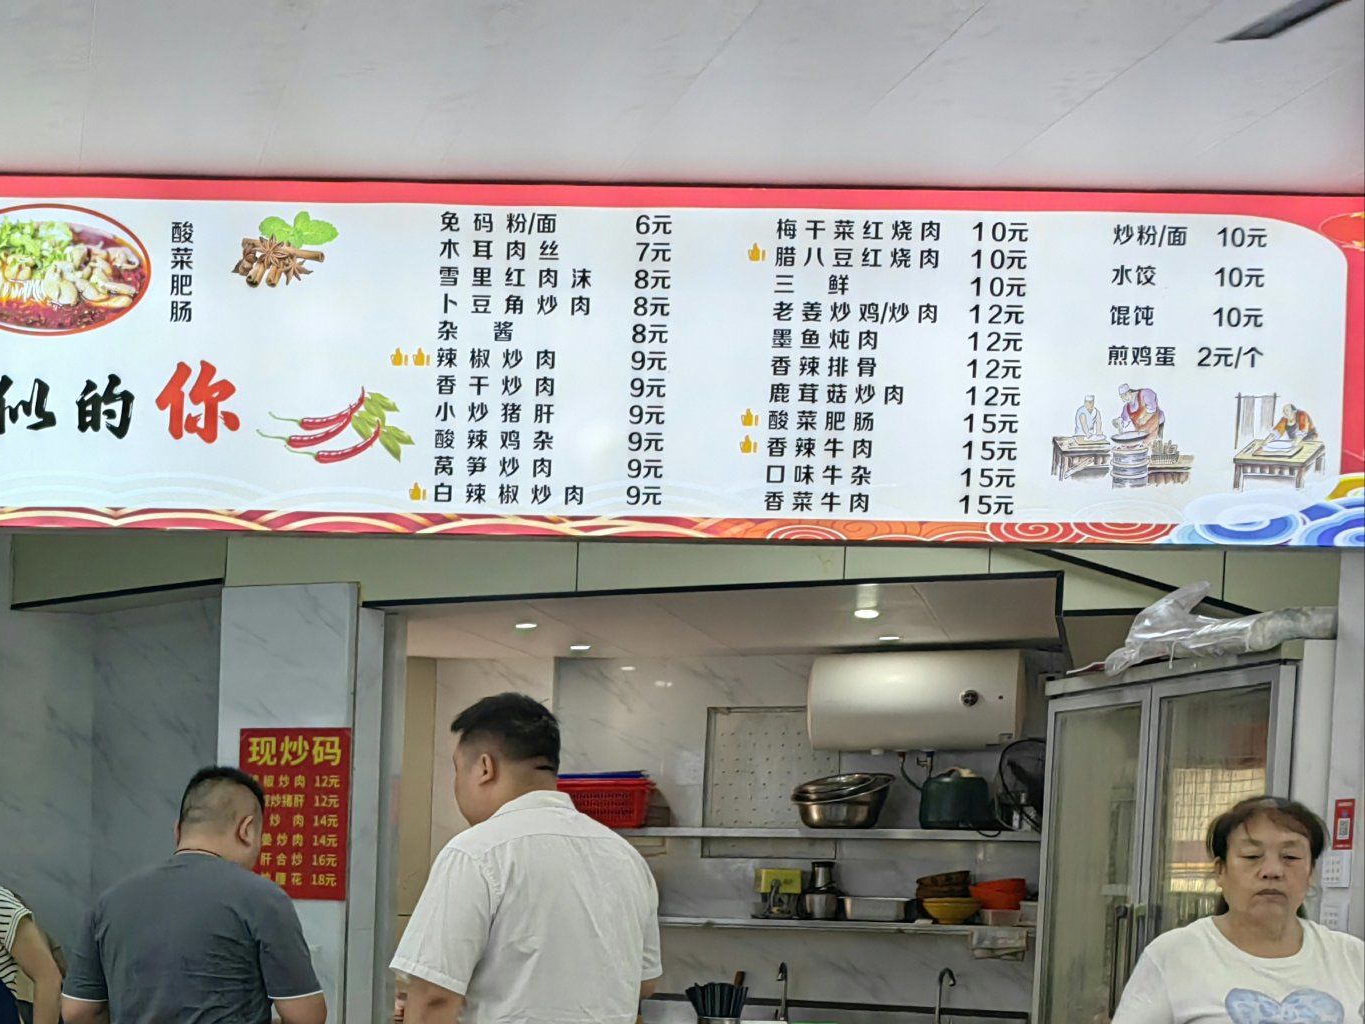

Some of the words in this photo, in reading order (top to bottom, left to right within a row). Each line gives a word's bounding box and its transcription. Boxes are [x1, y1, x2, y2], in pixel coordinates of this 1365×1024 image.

[441, 211, 556, 234] 免码粉/面
[636, 215, 672, 234] 6元
[777, 219, 940, 241] 梅干菜红烧肉
[973, 222, 1028, 242] 10元
[1114, 225, 1187, 247] 炒粉/面
[1218, 227, 1267, 247] 10元
[440, 239, 559, 260] 木耳肉丝
[636, 243, 671, 262] 7元
[775, 247, 939, 268] 腊八豆红烧肉
[972, 250, 1027, 269] 10元
[170, 221, 193, 322] 酸菜肥肠
[440, 267, 591, 288] 雪里红肉沫
[635, 269, 670, 289] 8元
[1112, 265, 1155, 285] 水饺
[1215, 267, 1264, 287] 10元
[774, 274, 848, 295] 三鲜
[971, 277, 1026, 297] 10元
[444, 294, 590, 315] 卜豆角炒肉
[634, 297, 669, 316] 8元
[773, 301, 937, 324] 老姜炒鸡/炒肉
[970, 304, 1024, 324] 12元
[1110, 305, 1154, 326] 馄饨
[1214, 307, 1263, 327] 10元
[438, 320, 513, 341] 杂酱
[632, 324, 668, 343] 8元
[772, 329, 877, 350] 墨鱼炖肉
[968, 332, 1022, 351] 12元
[437, 348, 555, 369] 辣椒炒肉
[632, 351, 667, 370] 9元
[771, 356, 876, 377] 香辣排骨
[967, 359, 1021, 379] 12元
[1108, 345, 1175, 366] 煎鸡蛋
[1198, 347, 1263, 368] 2元/个
[437, 375, 554, 396] 香干炒肉
[631, 378, 666, 397] 9元
[769, 383, 903, 404] 鹿茸菇炒肉
[966, 386, 1020, 406] 12元
[436, 402, 554, 423] 小炒猪肝
[630, 405, 664, 424] 9元
[769, 410, 873, 431] 酸菜肥肠
[964, 414, 1018, 433] 15元
[435, 429, 553, 450] 酸辣鸡杂
[628, 432, 663, 451] 9元
[767, 437, 872, 458] 香辣牛肉
[963, 441, 1017, 460] 15元
[435, 456, 551, 477] 莴笋炒肉
[628, 459, 663, 478] 9元
[767, 465, 871, 485] 口味牛杂
[961, 468, 1015, 487] 15元
[435, 483, 583, 505] 白辣椒炒肉
[627, 486, 661, 505] 9元
[765, 491, 869, 512] 香菜牛肉
[959, 495, 1013, 515] 15元
[248, 735, 342, 766] 现炒码
[252, 775, 306, 788] 椒炒肉
[315, 775, 340, 788] 12元
[314, 795, 340, 808] 12元
[313, 814, 339, 828] 14元
[313, 834, 338, 847] 14元
[312, 853, 338, 867] 16元
[311, 873, 337, 887] 18元
